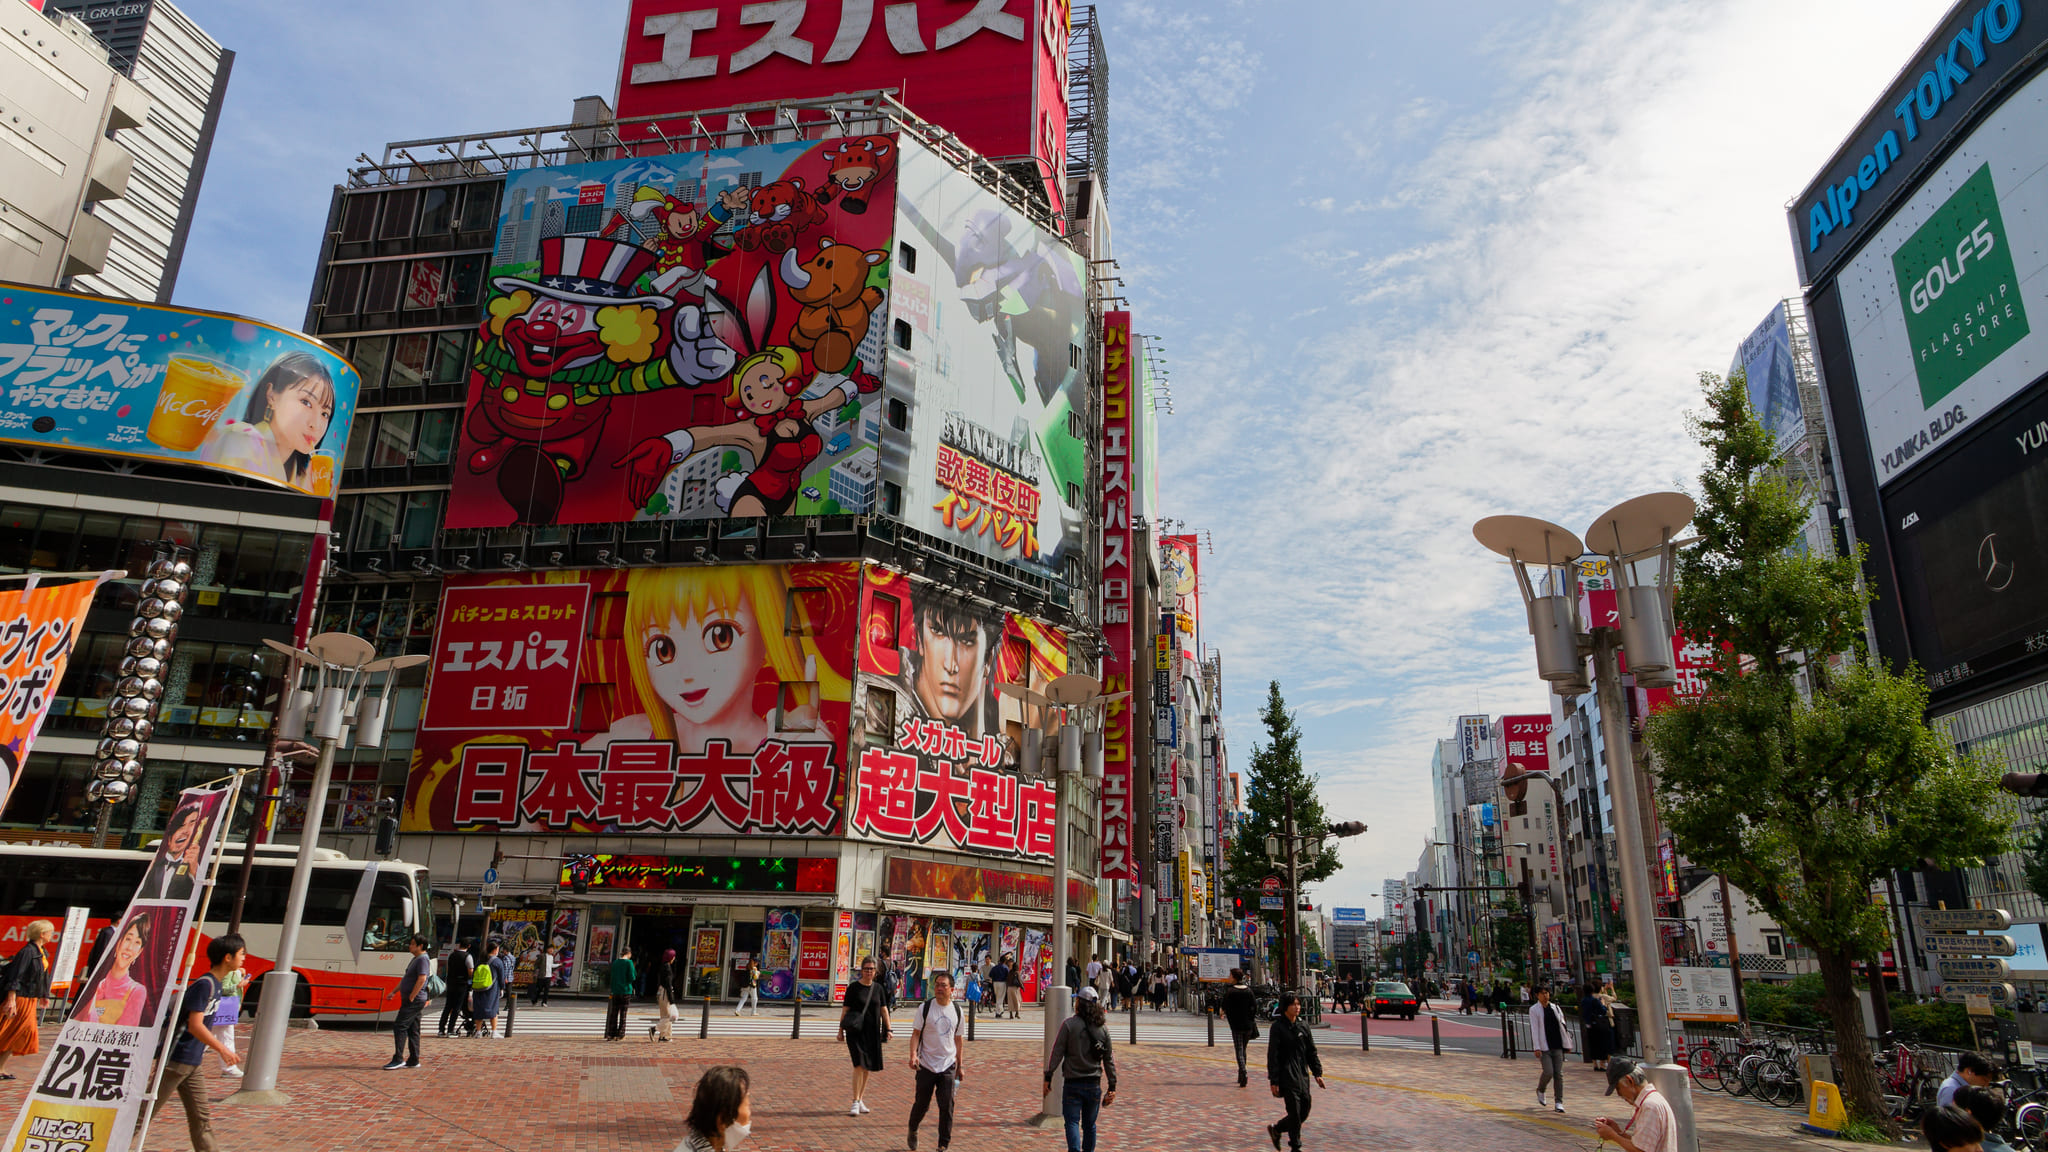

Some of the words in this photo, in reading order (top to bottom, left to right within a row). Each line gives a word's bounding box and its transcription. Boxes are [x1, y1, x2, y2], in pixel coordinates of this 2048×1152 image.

[90, 3, 148, 20] GRACERY
[1809, 130, 1901, 253] Alpen
[1895, 0, 2022, 143] TOKYO
[1909, 218, 1994, 314] GOLF5
[29, 308, 149, 353] マックに
[1921, 284, 2007, 362] FLAGSHIP
[1955, 303, 2013, 356] STORE
[0, 343, 170, 389] フラッペが
[1106, 322, 1128, 419] パチンコ
[9, 385, 121, 411] やってきた!
[940, 410, 1042, 484] EVANGELION
[1880, 429, 1930, 474] YUNIKA
[1929, 404, 1968, 442] BLDG.
[935, 443, 1042, 524] 歌舞伎町
[1104, 427, 1128, 569] エスパス
[932, 489, 1040, 558] インパクト
[451, 604, 577, 624] パチンコ&スロット
[1103, 577, 1129, 625] 日拓
[0, 612, 76, 669] ウィン
[441, 630, 570, 672] エスパス
[470, 685, 529, 712] 日拓
[1103, 671, 1127, 763] パチンコ
[897, 716, 1005, 769] メガホール
[453, 738, 842, 834] 日本最大級
[851, 747, 1056, 860] 超大型店
[1102, 774, 1128, 874] エスパス
[379, 953, 394, 961] 669
[803, 951, 828, 960] エスパス
[36, 1043, 131, 1102] 12億
[28, 1116, 94, 1142] MEGA
